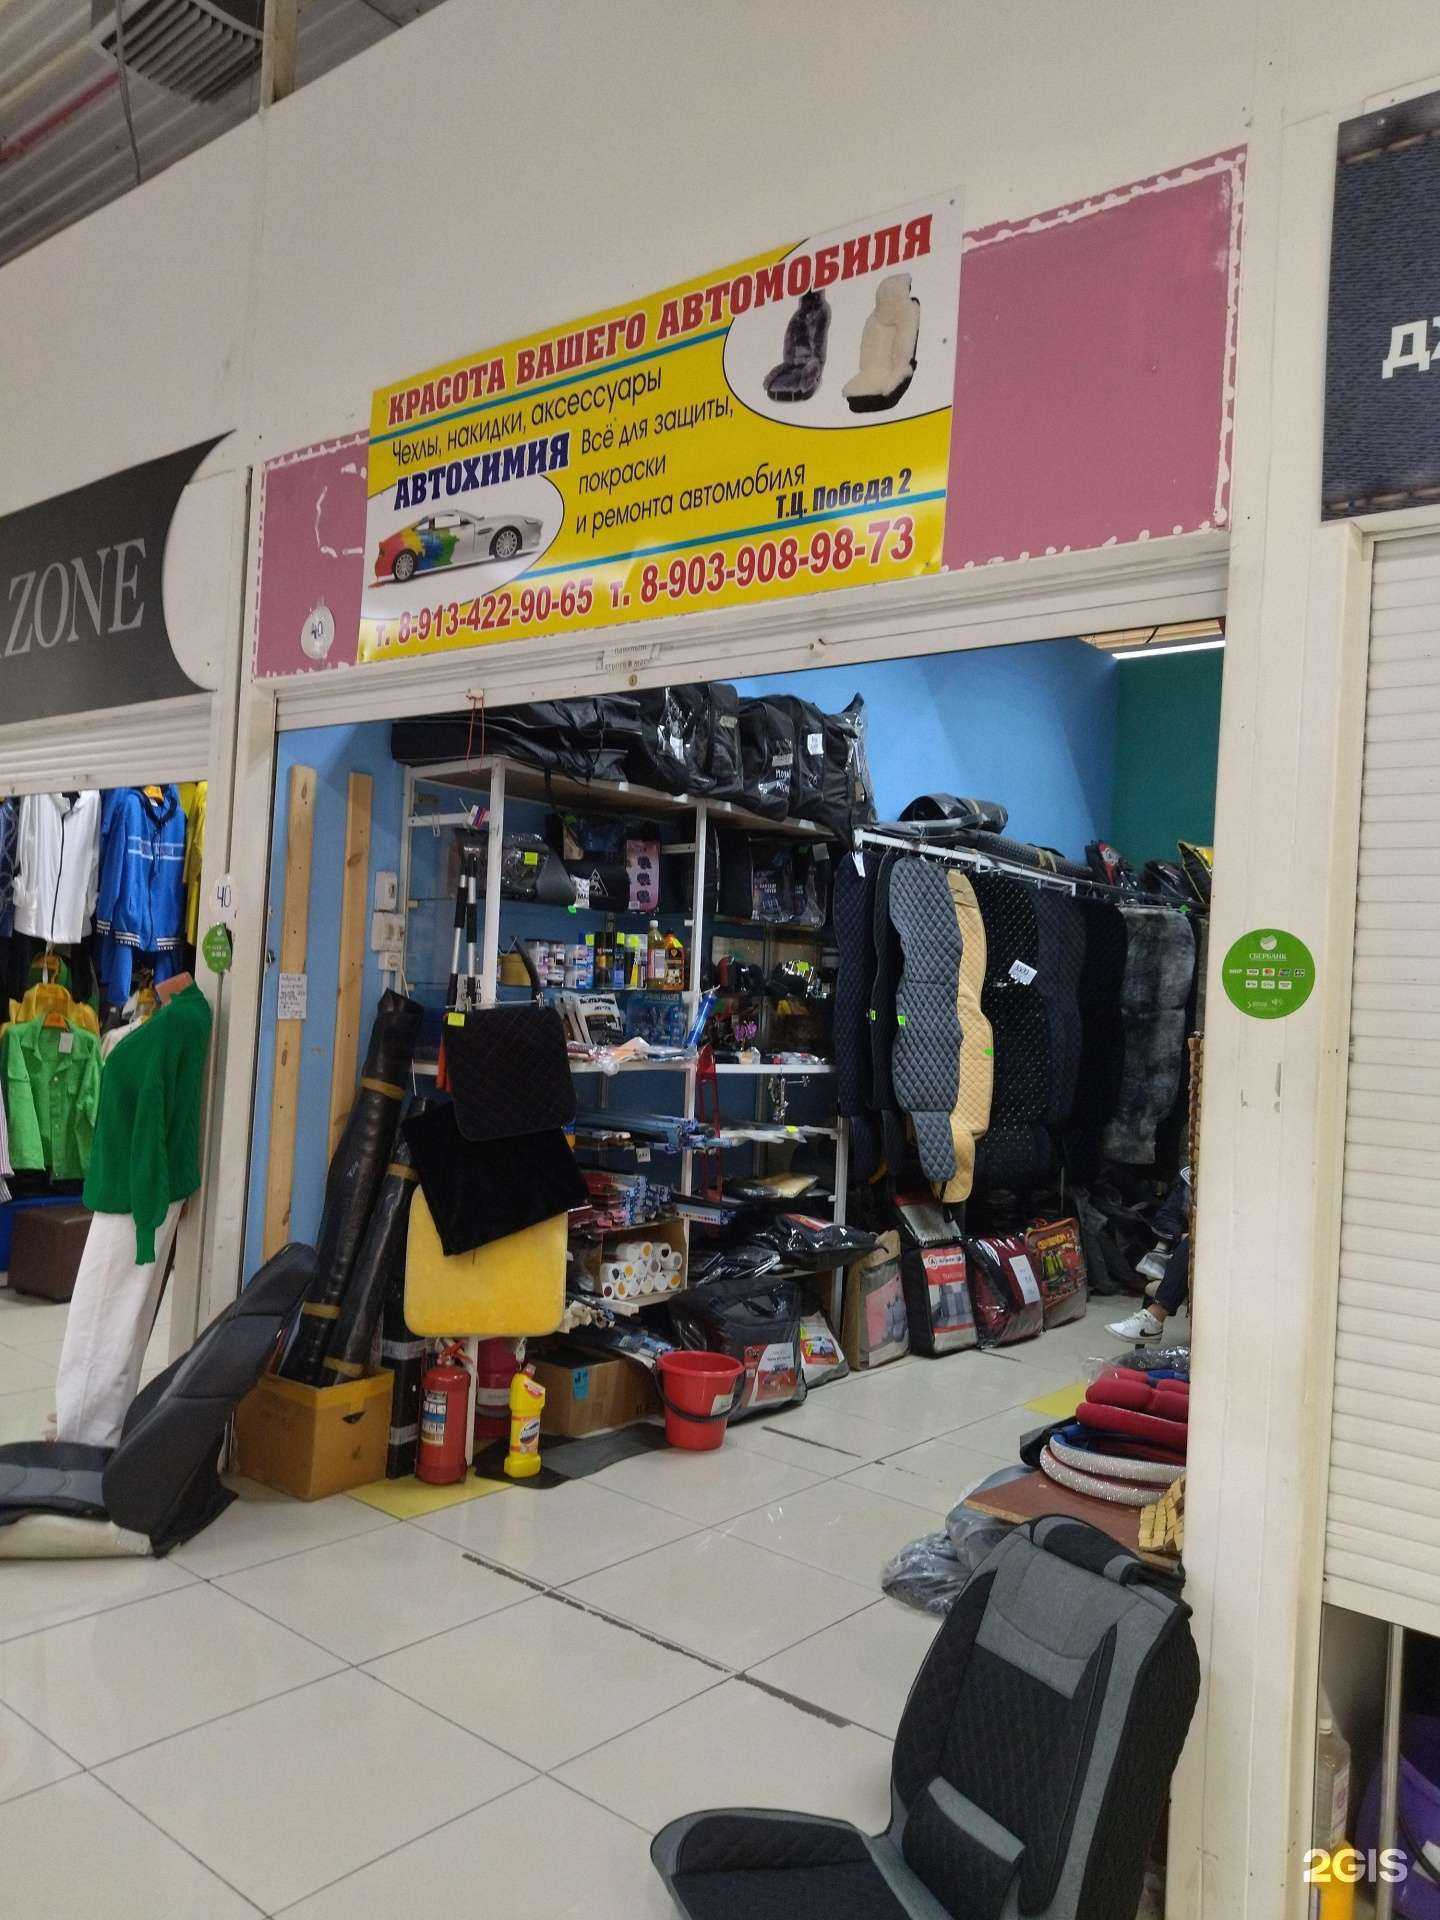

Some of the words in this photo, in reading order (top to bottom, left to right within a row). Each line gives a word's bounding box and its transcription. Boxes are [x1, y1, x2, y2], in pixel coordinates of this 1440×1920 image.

[387, 358, 506, 426] КРАСОТА
[516, 312, 646, 385] ВАШЕГО
[657, 213, 934, 340] АВТОМОБИЛЯ
[392, 438, 443, 466] Чехлы,
[447, 411, 527, 452] накидки,
[531, 367, 662, 426] аксессуары
[581, 424, 614, 455] Всё
[619, 417, 648, 446] для
[654, 396, 734, 435] защиты,
[393, 432, 570, 511] АВТОХИМИЯ
[576, 514, 587, 534] и
[592, 494, 674, 537] ремонта
[680, 462, 807, 508] автомобиля
[578, 455, 666, 496] покраски
[775, 490, 808, 519] Т.Ц.
[812, 476, 893, 513] Победа
[898, 467, 913, 494] 2
[4, 538, 146, 657] ZONE
[398, 577, 594, 644] 8-913-422-90-65
[641, 516, 914, 603] 8-903-908-98-73
[216, 884, 232, 908] 40
